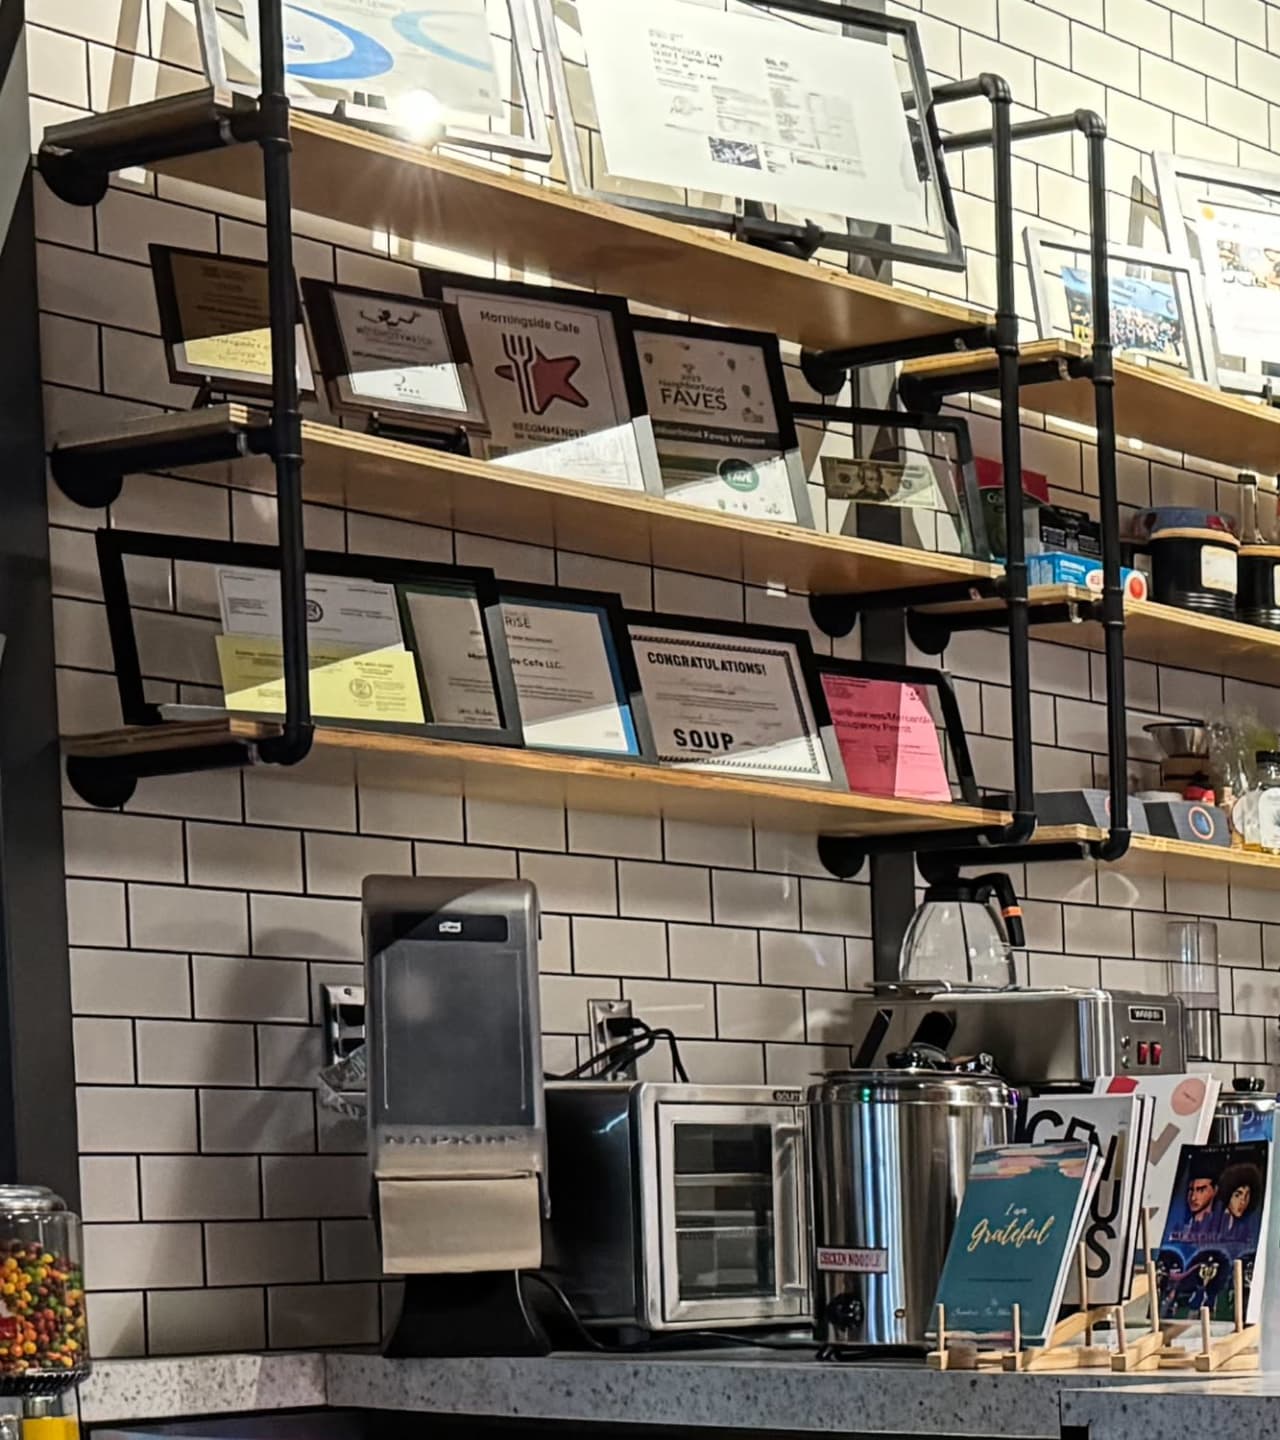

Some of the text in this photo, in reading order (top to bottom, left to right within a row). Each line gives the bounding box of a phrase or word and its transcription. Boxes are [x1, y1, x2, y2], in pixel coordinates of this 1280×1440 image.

[480, 310, 580, 334] Morningside Cafe
[661, 388, 728, 412] FAVES
[647, 650, 768, 677] CONGRATULATIONS!
[673, 728, 734, 751] SOUP
[966, 1215, 1056, 1253] Grateful
